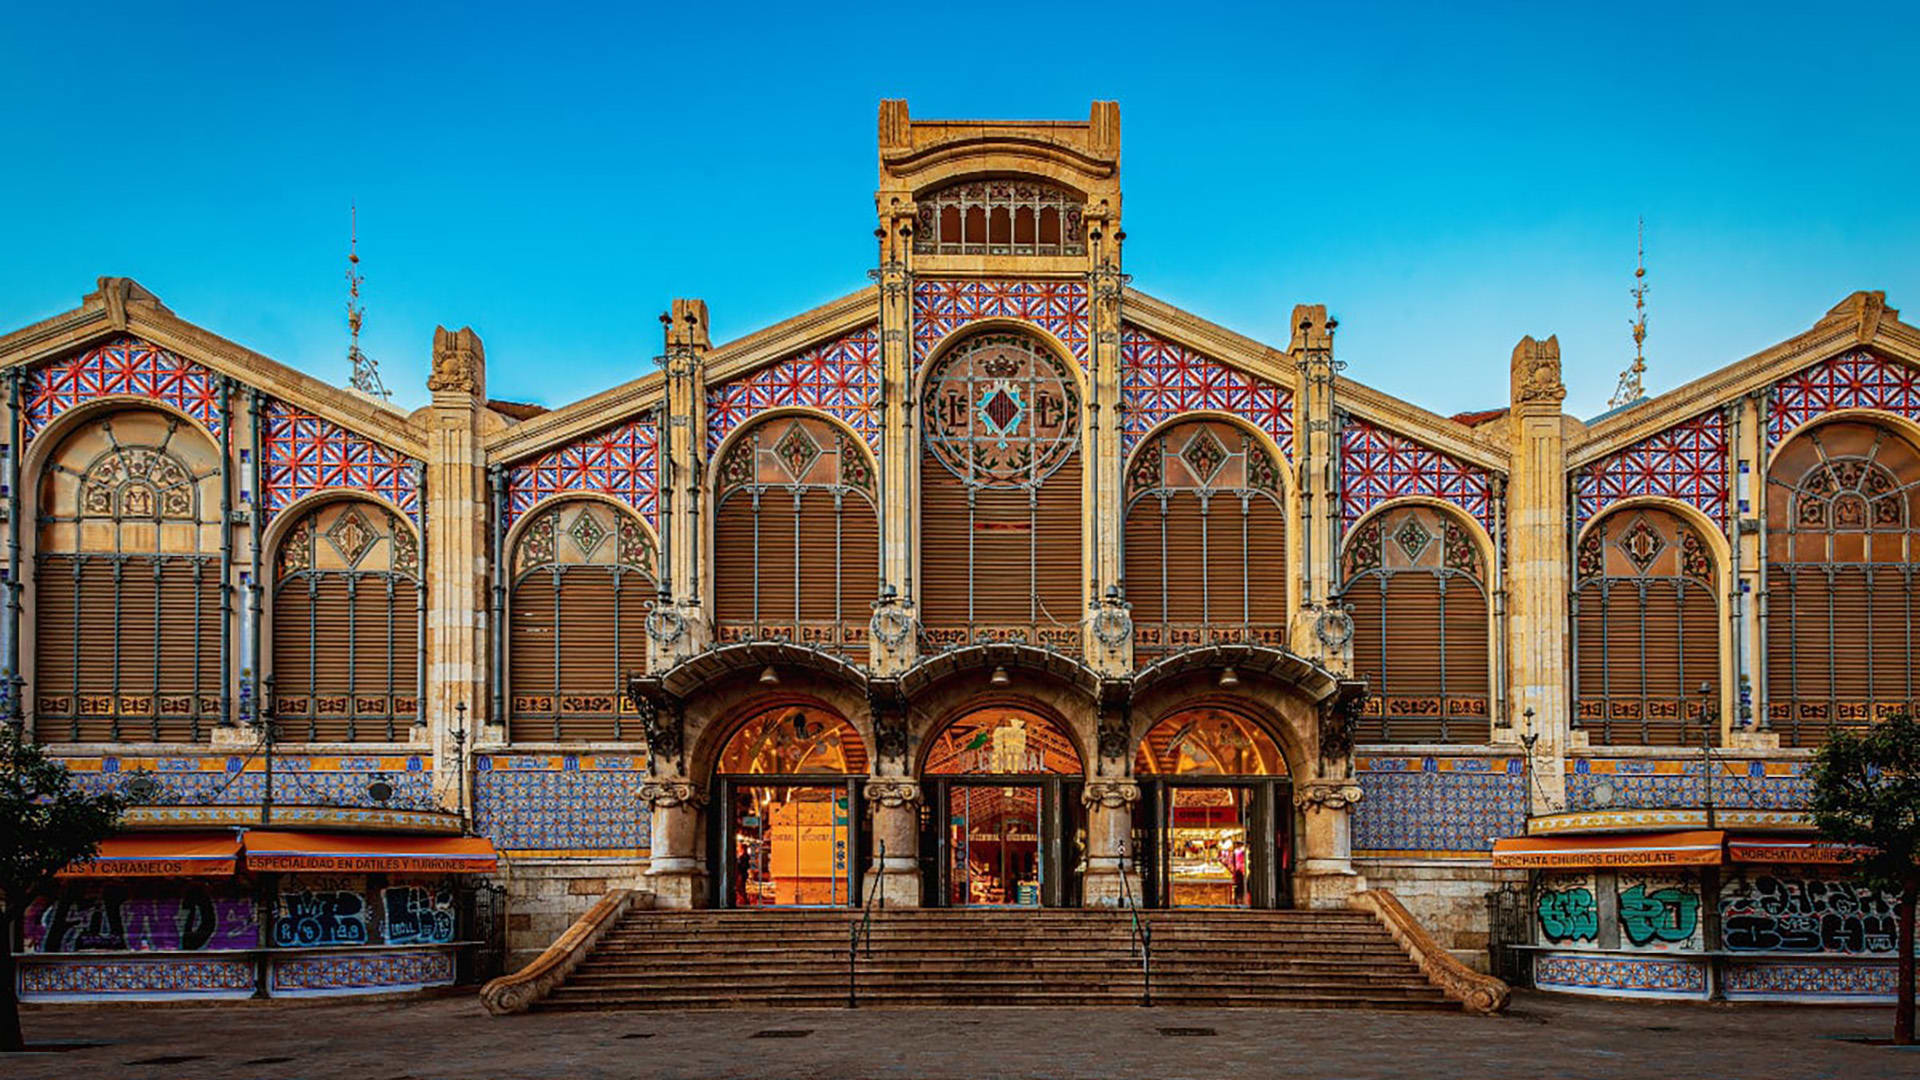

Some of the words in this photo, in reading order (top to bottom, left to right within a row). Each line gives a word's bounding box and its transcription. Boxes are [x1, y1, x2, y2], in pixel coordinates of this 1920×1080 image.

[1551, 853, 1602, 865] CHURROS
[1605, 851, 1676, 865] CHOCOLATE
[1741, 849, 1799, 861] HORCHATA
[101, 862, 182, 873] CARAMELOS
[248, 858, 335, 869] ESPECIALIDAD
[337, 859, 353, 869] EN
[355, 859, 400, 870] DATILES
[401, 859, 410, 870] Y
[411, 859, 465, 871] TURRONES
